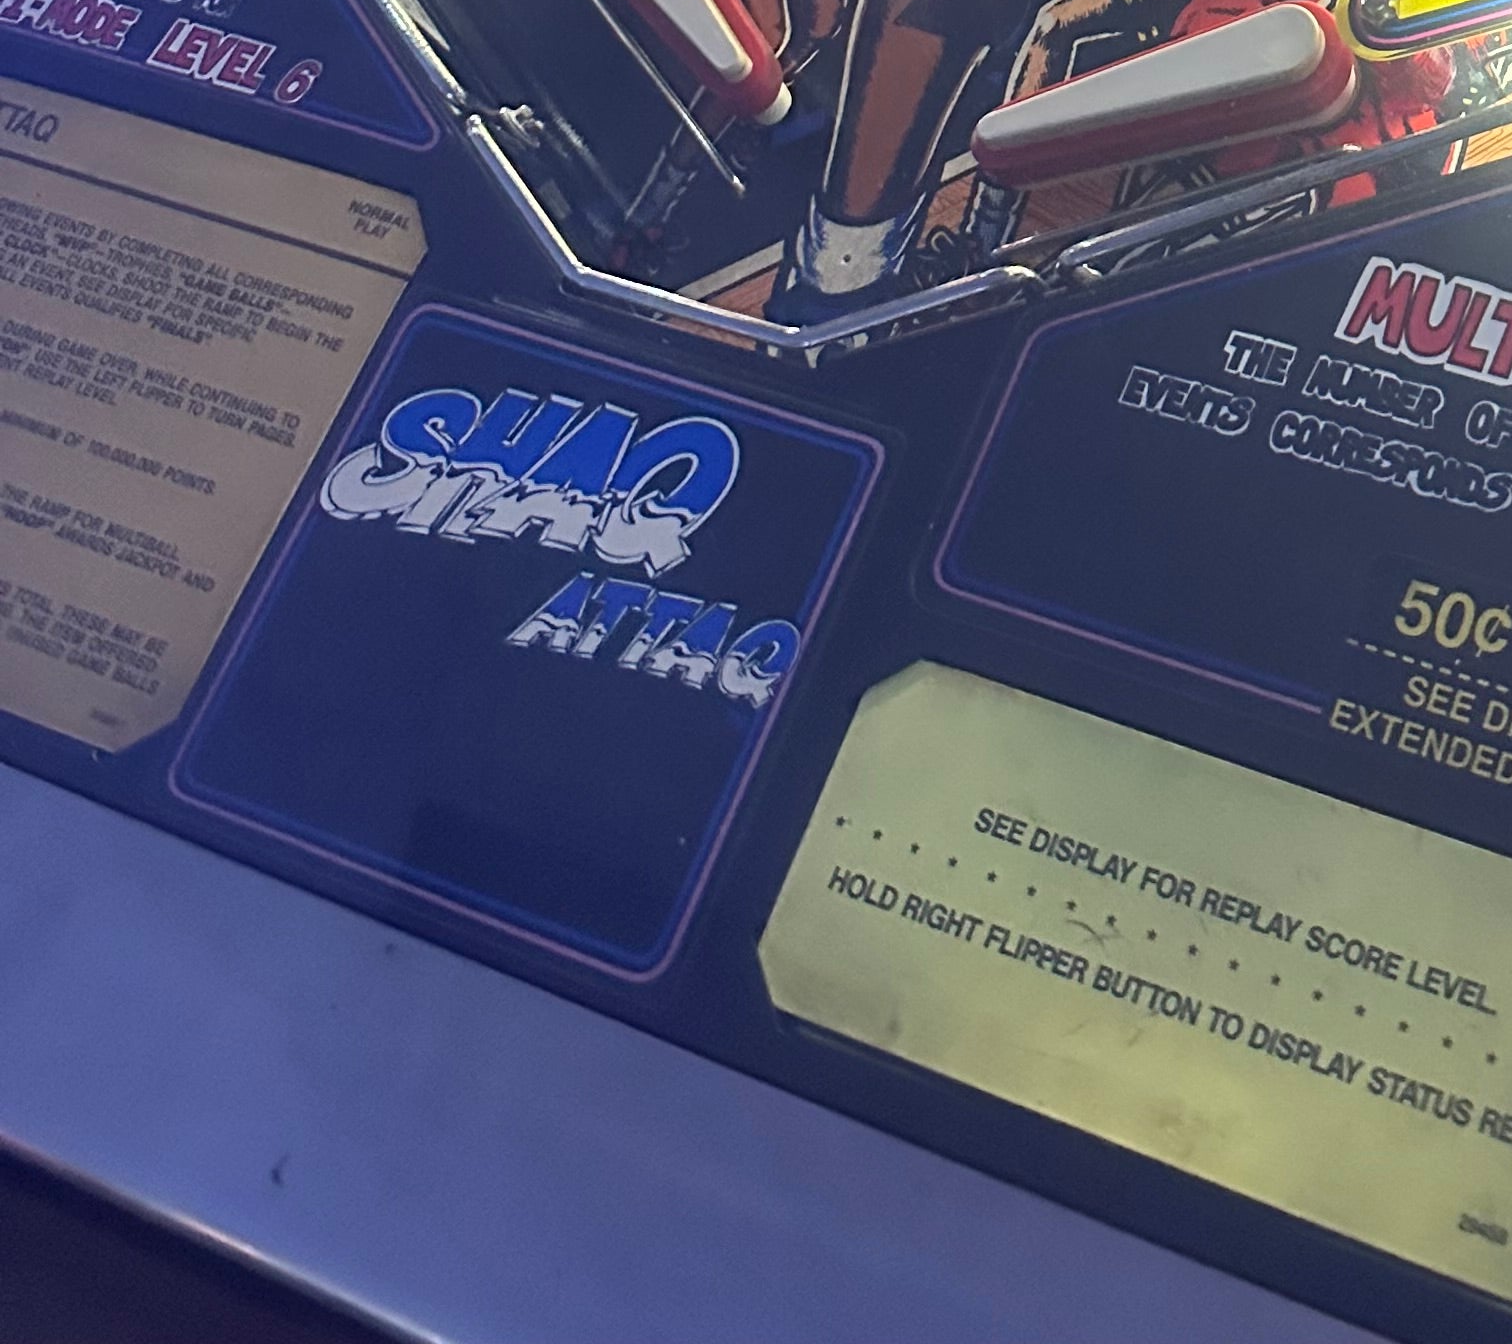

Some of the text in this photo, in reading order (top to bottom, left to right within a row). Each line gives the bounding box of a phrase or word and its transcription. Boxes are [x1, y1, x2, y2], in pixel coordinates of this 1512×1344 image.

[147, 18, 277, 95] LEVEL
[274, 58, 324, 105] 6
[0, 101, 60, 144] TAQ
[347, 199, 411, 231] NORMAL
[352, 216, 391, 240] PLAY
[18, 273, 73, 301] EVENTS
[74, 290, 143, 323] QUALIFIES
[43, 212, 97, 238] EVENTS
[97, 228, 117, 244] BY
[118, 235, 204, 274] COMPLETING
[206, 262, 229, 282] ALL
[233, 271, 354, 321] CORRESPONDING
[77, 274, 106, 294] SEE
[106, 283, 163, 311] DISPLAY
[163, 301, 194, 322] FOR
[122, 271, 173, 297] SHOOT
[174, 287, 201, 308] THE
[246, 310, 264, 327] TO
[313, 330, 346, 353] THE
[92, 369, 128, 391] LEFT
[186, 398, 206, 417] TO
[144, 367, 190, 393] WHILE
[190, 382, 278, 423] CONTINUING
[280, 411, 301, 430] TO
[1118, 365, 1257, 436] EVENTS
[1222, 329, 1297, 386] THE
[1302, 355, 1445, 430] NUMBER
[319, 386, 741, 578] SHAQ
[181, 569, 217, 593] AND
[505, 570, 801, 709] ATTAQ
[1402, 674, 1477, 724] SEE
[973, 806, 1029, 848] SEE
[1028, 827, 1139, 885] DISPLAY
[1140, 865, 1198, 908] FOR
[1199, 886, 1304, 944] REPLAY
[1304, 925, 1406, 981] SCORE
[826, 865, 900, 912] HOLD
[900, 893, 985, 943] RIGHT
[982, 924, 1090, 985] FLIPPER
[1091, 965, 1204, 1028] BUTTON
[1207, 1004, 1244, 1042] TO
[1246, 1022, 1365, 1085] DISPLAY
[1365, 1065, 1475, 1128] STATUS
